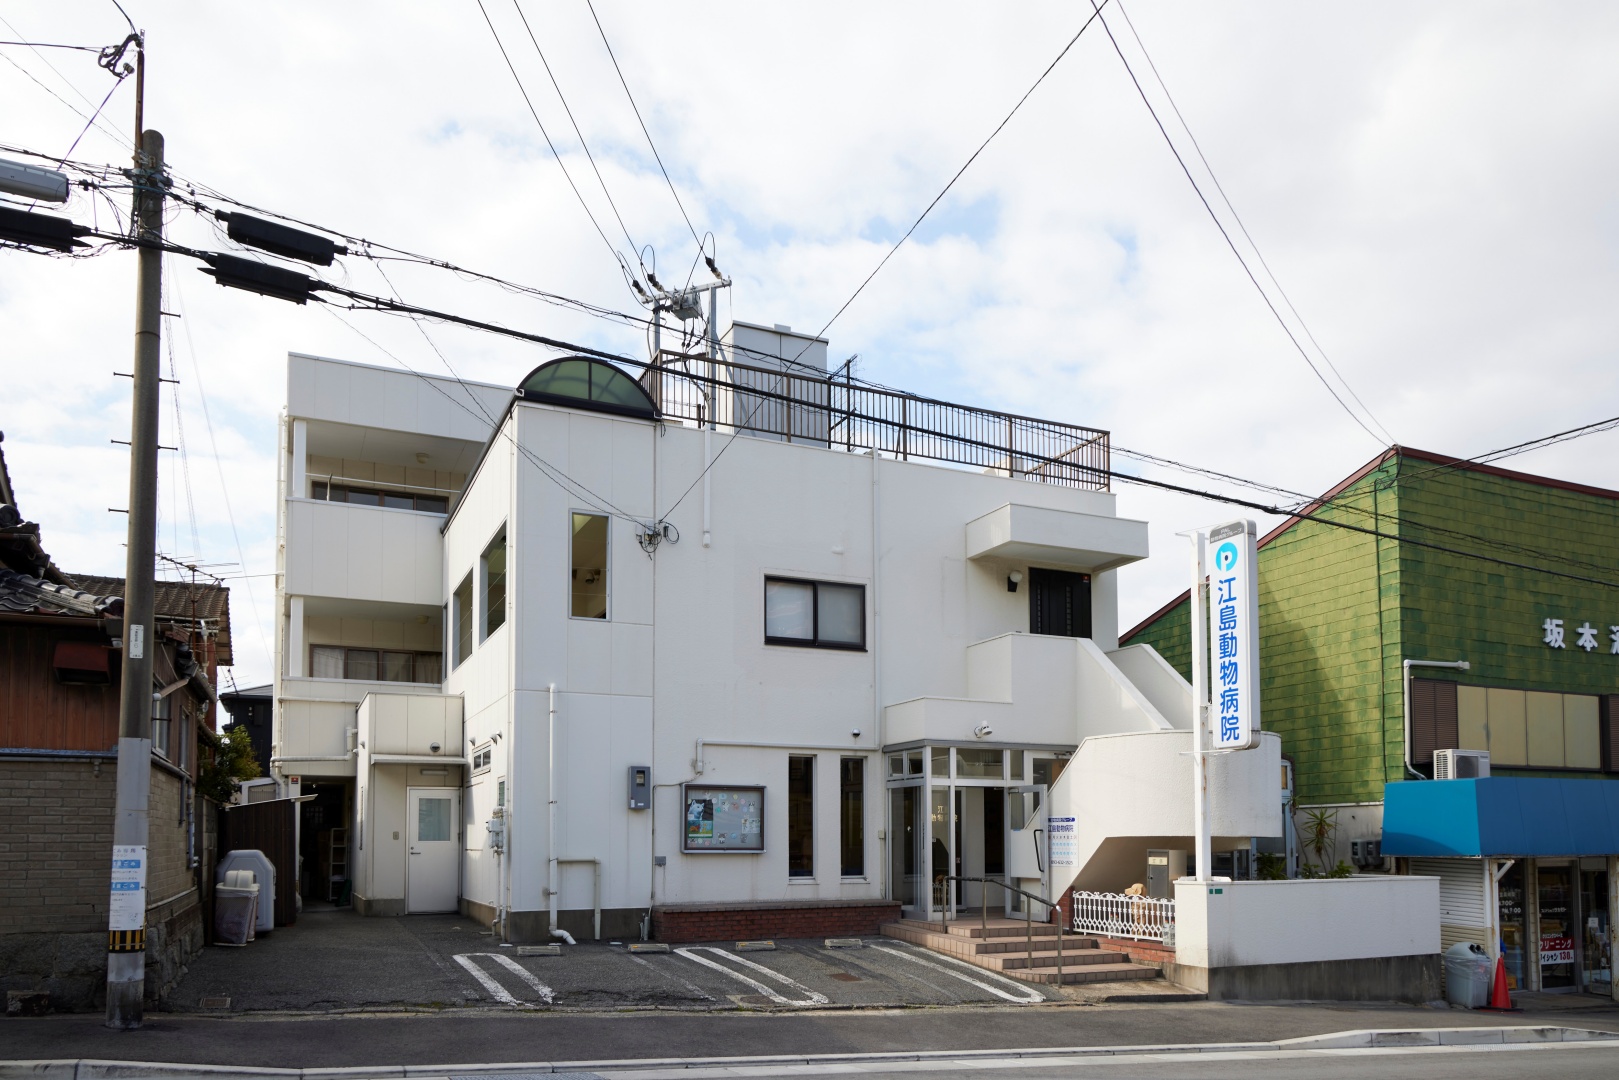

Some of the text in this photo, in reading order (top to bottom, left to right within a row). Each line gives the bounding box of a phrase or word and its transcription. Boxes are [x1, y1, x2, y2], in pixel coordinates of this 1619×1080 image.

[1217, 576, 1240, 743] 江島動物病院
